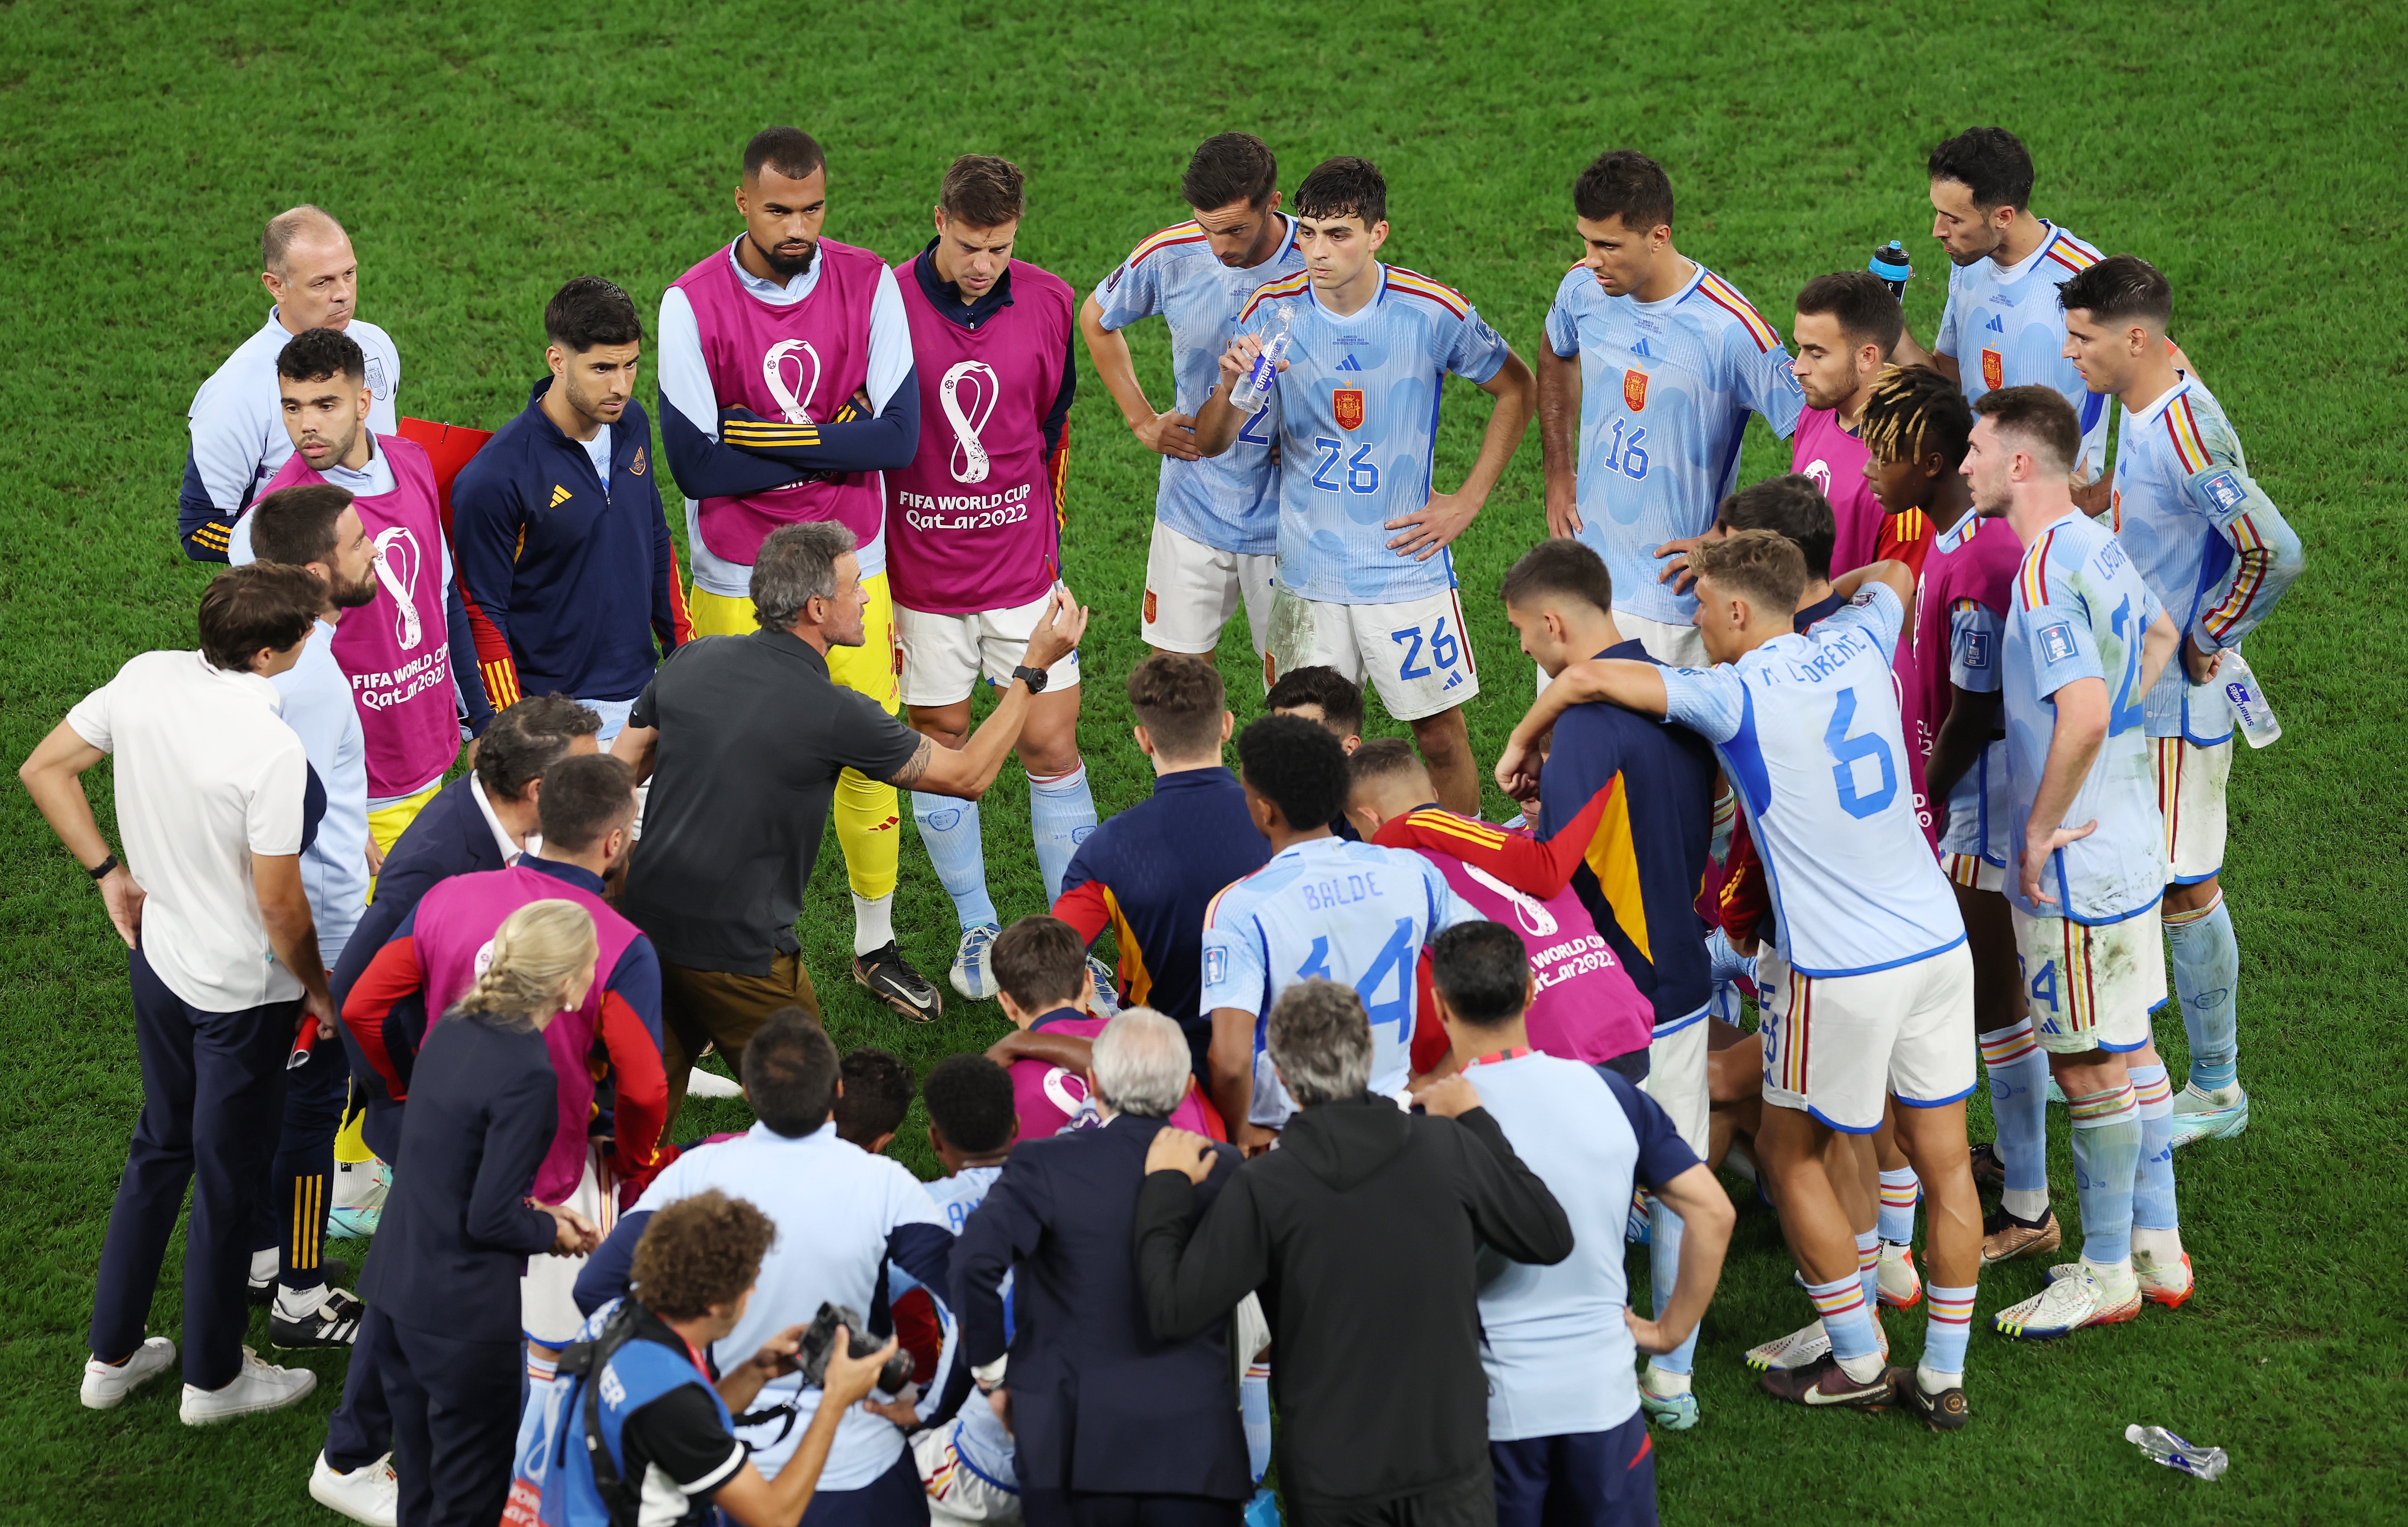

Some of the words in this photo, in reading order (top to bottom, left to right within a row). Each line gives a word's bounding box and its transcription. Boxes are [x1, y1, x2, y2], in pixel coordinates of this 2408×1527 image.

[1256, 342, 1282, 390] smartwater
[1311, 435, 1380, 495] 26
[1604, 416, 1650, 481] 16
[900, 491, 936, 510] FIFA
[938, 493, 1002, 510] WORLD
[1004, 484, 1031, 503] CUP
[906, 504, 1028, 532] Qatar2022
[352, 672, 394, 689] FIFA
[393, 654, 432, 684] WORLD
[435, 642, 448, 663] CUP
[1392, 616, 1459, 681] 26
[2109, 593, 2146, 738] 2
[362, 662, 445, 712] Qatar2022
[2228, 684, 2254, 726] smartwater
[1824, 687, 1897, 820] 6
[1302, 872, 1384, 911] BALDE
[1531, 938, 1587, 969] WORLD
[1533, 950, 1615, 1000] tar2022
